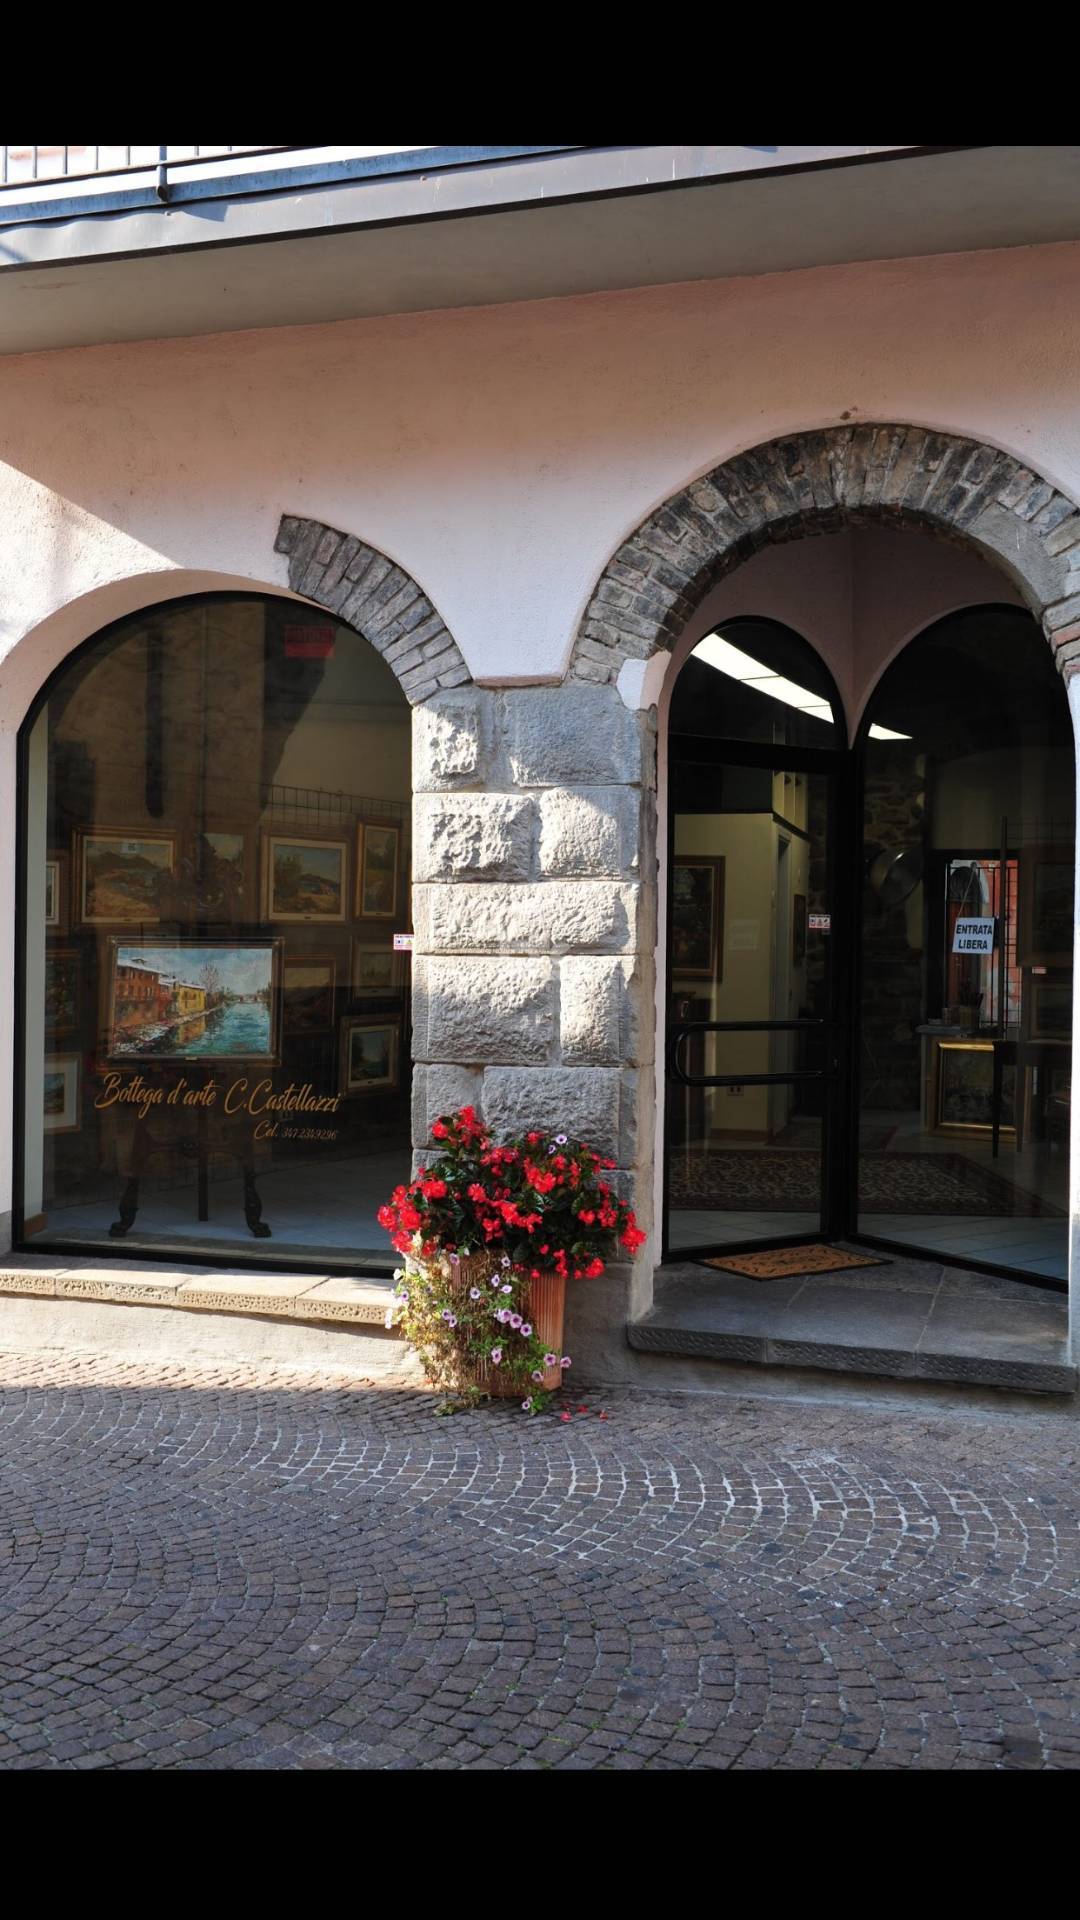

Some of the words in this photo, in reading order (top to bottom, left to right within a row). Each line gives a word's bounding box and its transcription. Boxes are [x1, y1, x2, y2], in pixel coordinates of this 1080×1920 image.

[956, 924, 993, 935] ENTRATA
[958, 939, 988, 950] LIBERA
[94, 1071, 164, 1119] Bottega
[166, 1078, 222, 1106] d'arte
